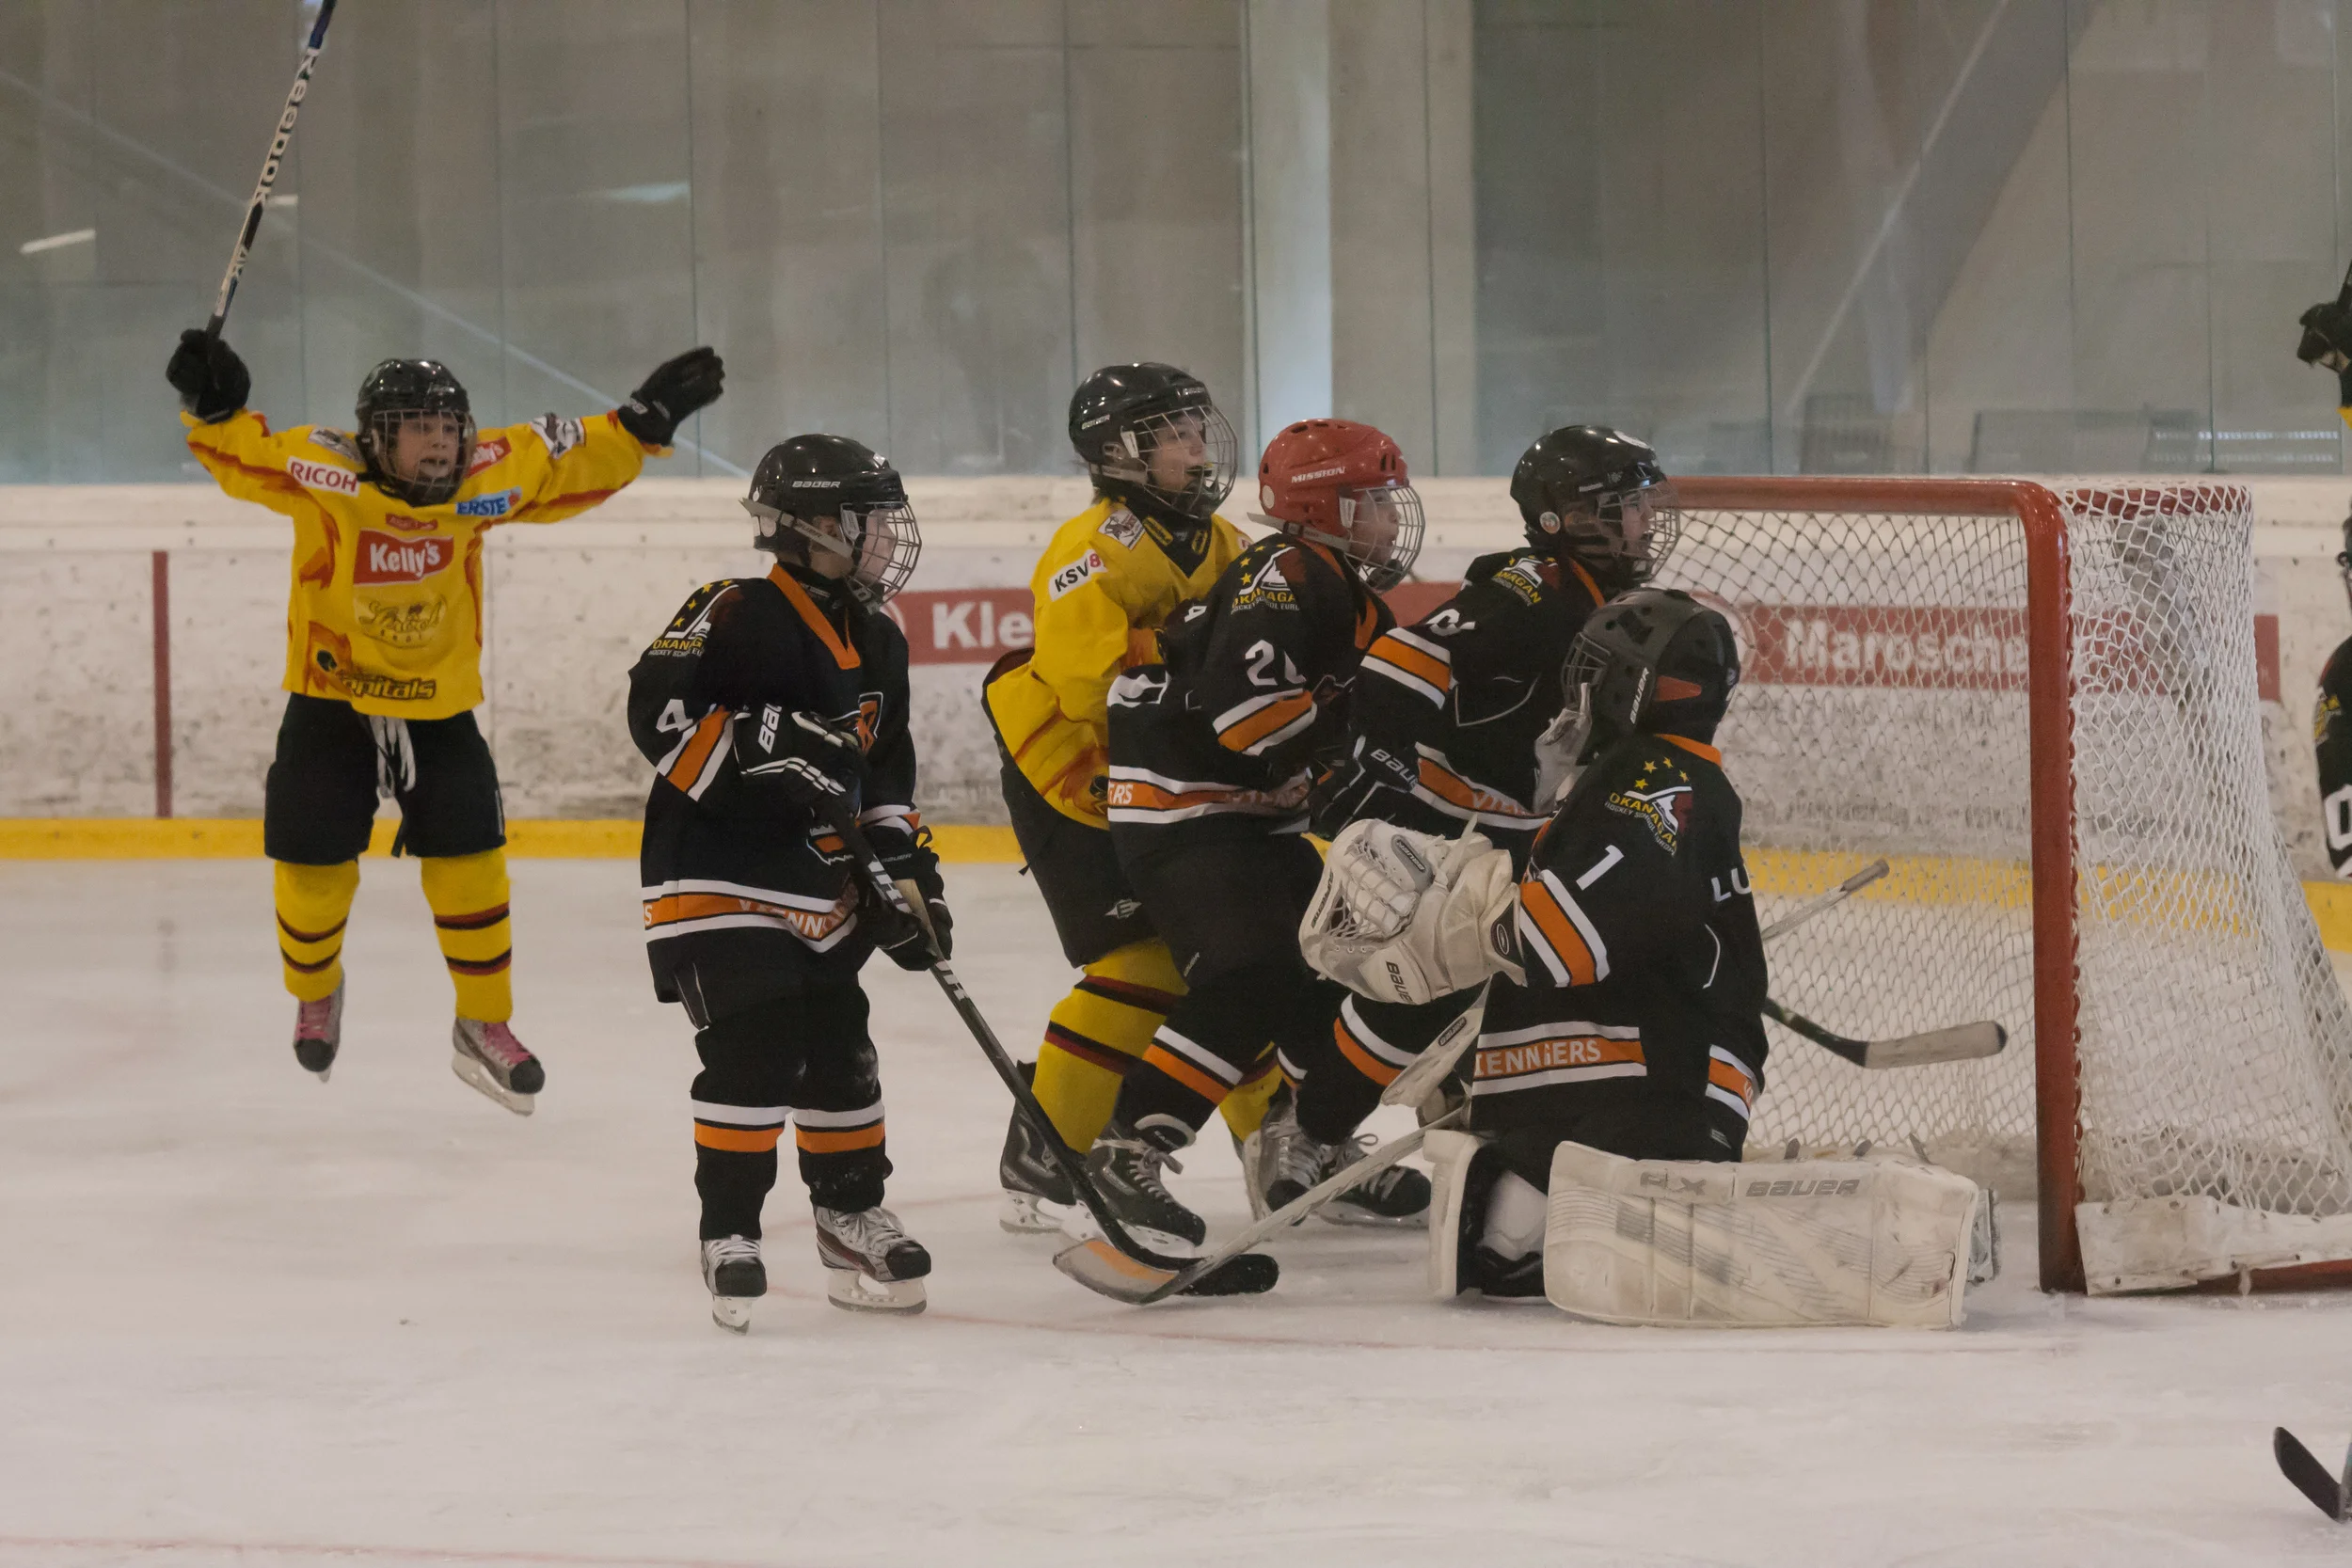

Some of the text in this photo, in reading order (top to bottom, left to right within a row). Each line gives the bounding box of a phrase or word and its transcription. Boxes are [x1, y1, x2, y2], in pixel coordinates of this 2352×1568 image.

[290, 460, 358, 493] RICOH
[1291, 466, 1346, 483] MISSION
[455, 496, 508, 516] ERSTE
[369, 540, 441, 578] Kelly's
[932, 600, 1034, 650] Kle
[656, 698, 693, 734] 4
[1575, 844, 1625, 892] 1
[1745, 1179, 1861, 1197] BAUER
